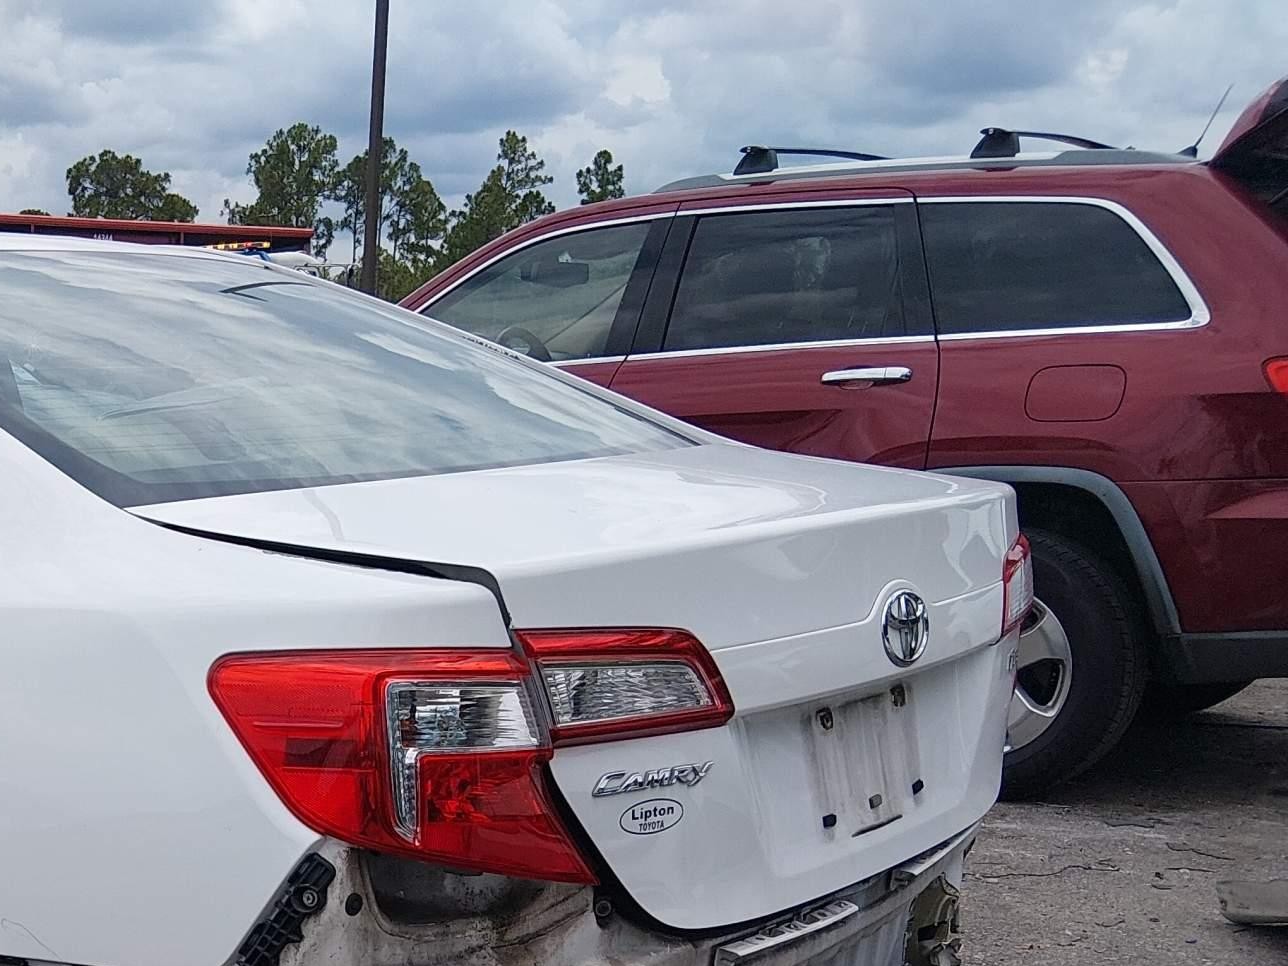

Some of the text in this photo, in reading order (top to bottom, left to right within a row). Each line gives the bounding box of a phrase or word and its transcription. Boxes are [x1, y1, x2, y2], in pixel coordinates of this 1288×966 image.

[593, 761, 714, 797] CAMRY
[632, 806, 674, 821] Lipton
[638, 820, 665, 832] TOYOTA
